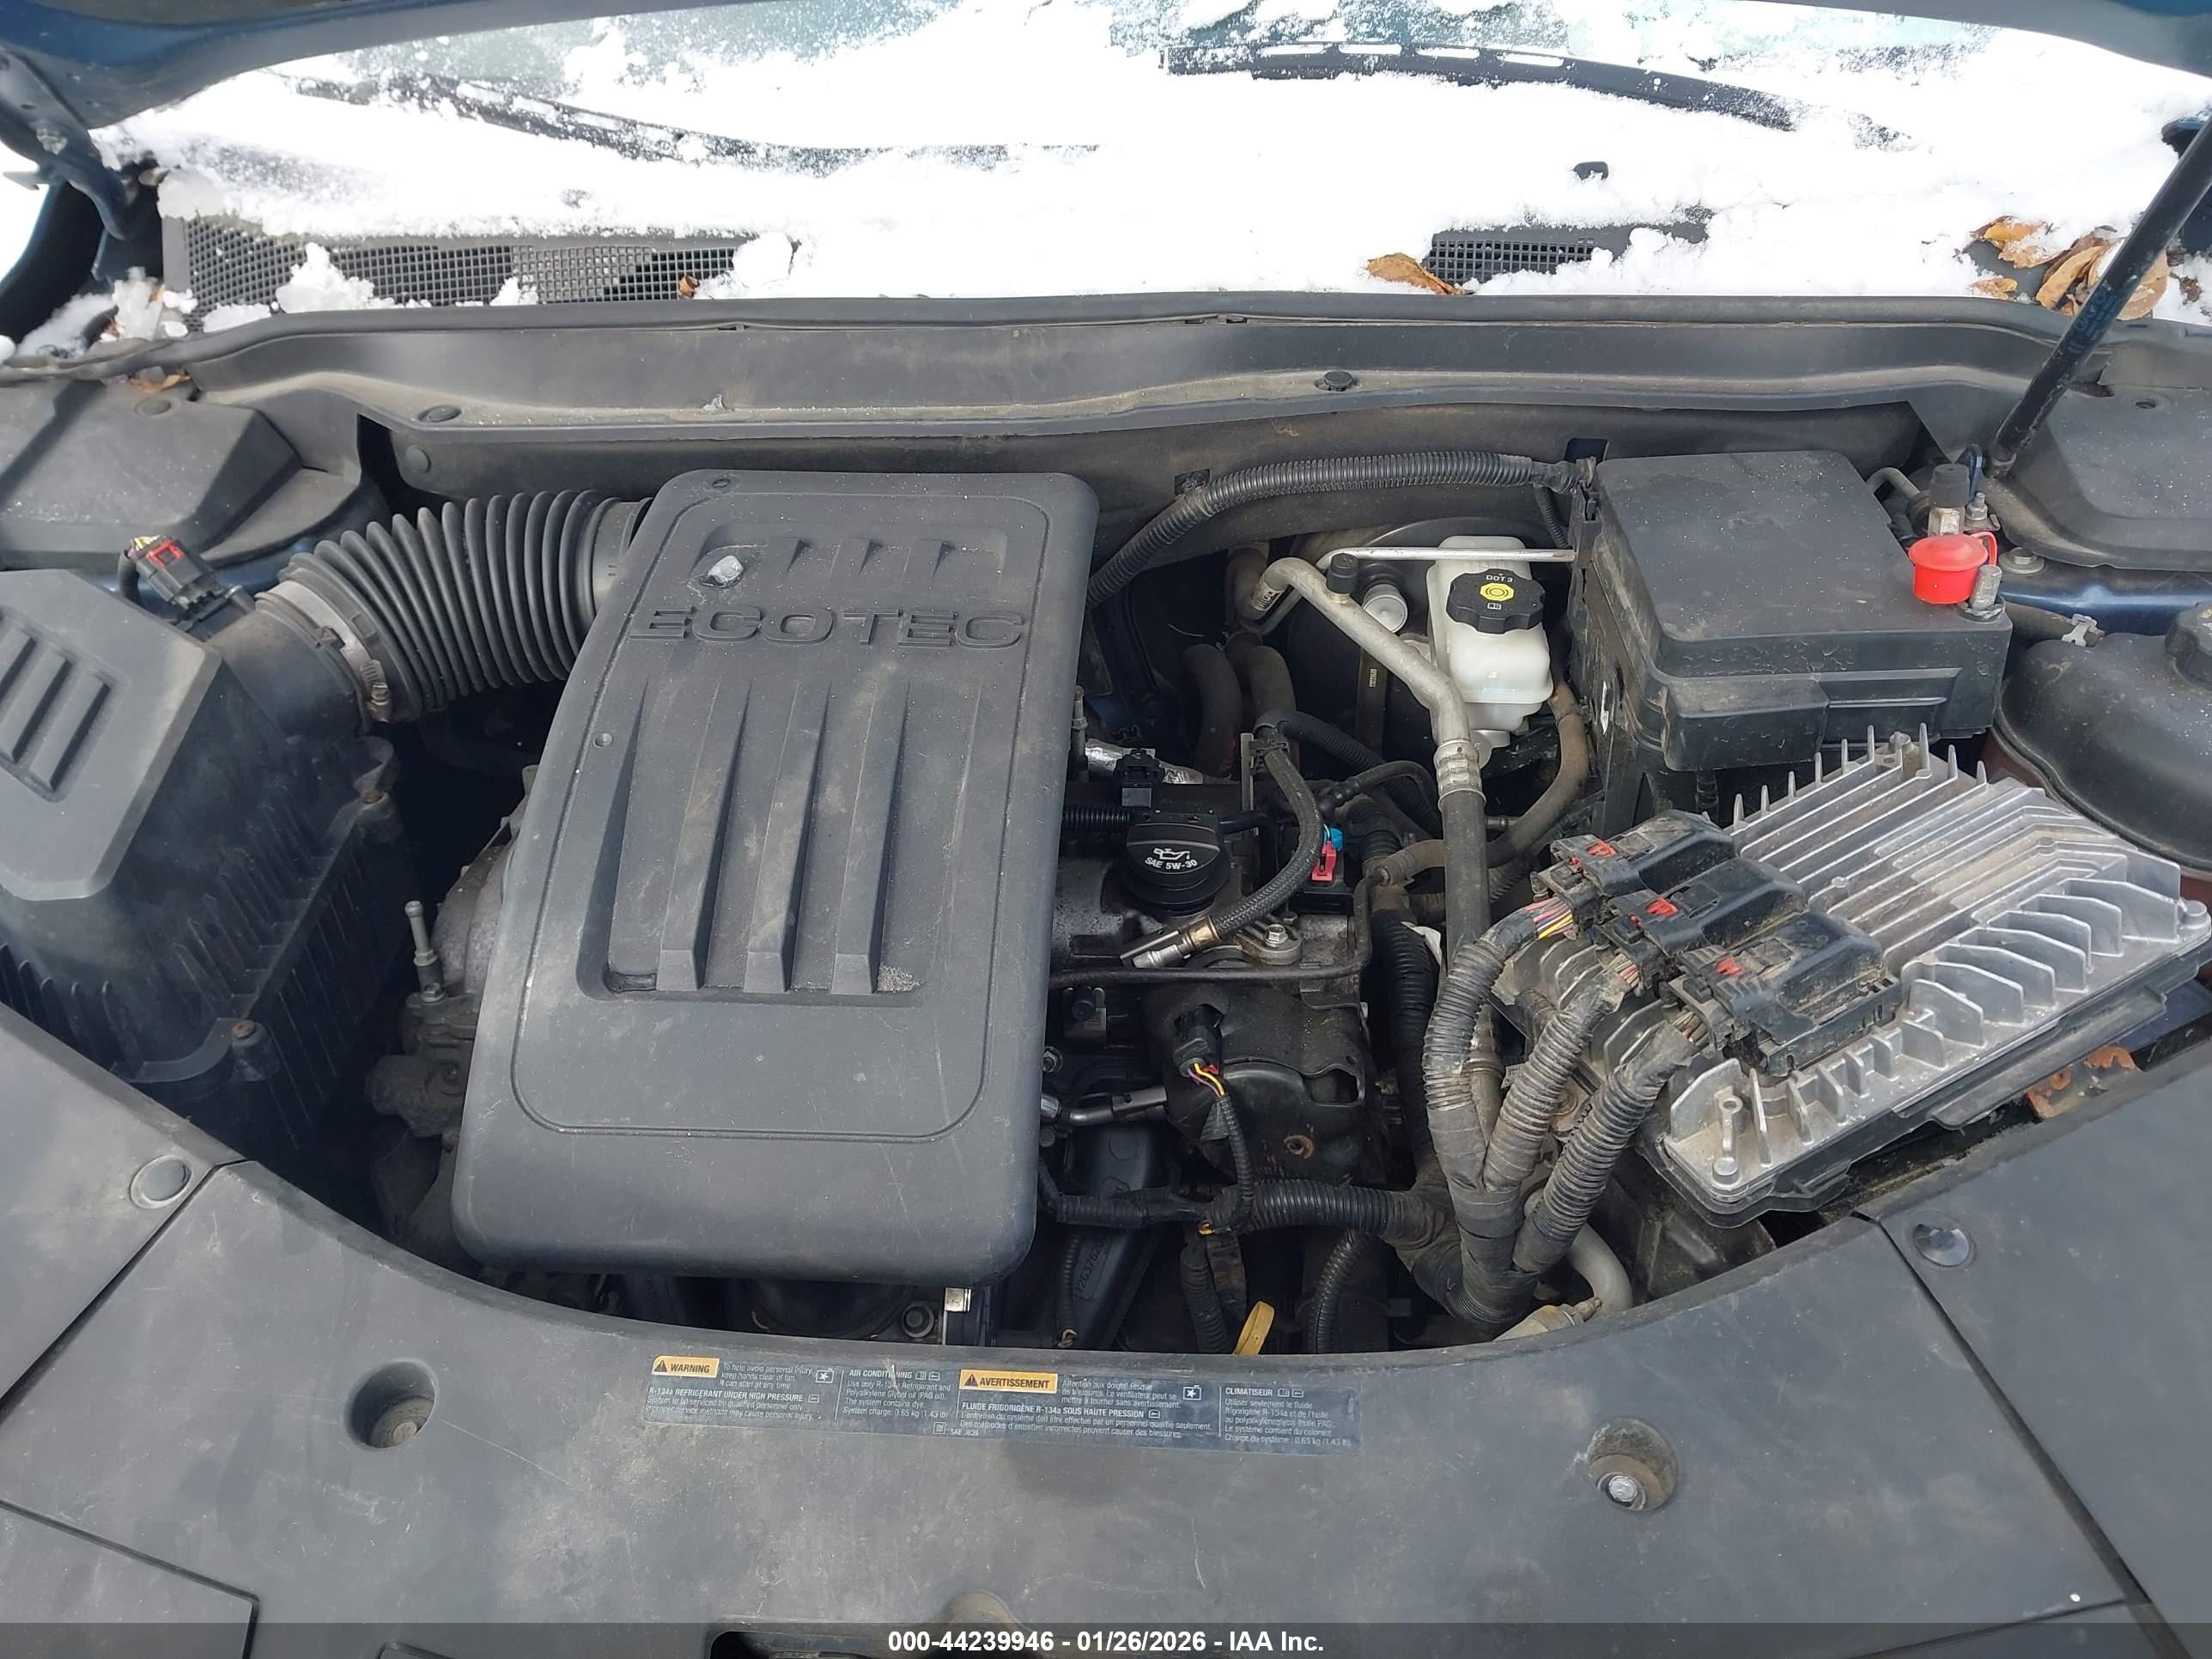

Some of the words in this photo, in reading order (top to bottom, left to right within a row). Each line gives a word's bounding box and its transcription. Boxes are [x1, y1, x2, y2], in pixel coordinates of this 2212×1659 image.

[629, 605, 1030, 650] ECOTEC
[1145, 857, 1164, 869] SAE
[1165, 859, 1198, 870] 5W-30
[671, 1363, 710, 1374] WARNING
[732, 1364, 744, 1372] help
[766, 1365, 793, 1375] personal
[863, 1370, 912, 1379] CONDITINING
[861, 1381, 875, 1389] only
[902, 1382, 937, 1391] Refrigerant
[980, 1376, 1050, 1389] AVERTISSEMENT
[1062, 1379, 1091, 1389] Attention
[1130, 1382, 1153, 1391] Risque
[675, 1389, 722, 1398] REFRIGERANT
[767, 1393, 804, 1401] PRESSURE
[846, 1389, 885, 1398] Polyalkylene
[1225, 1387, 1273, 1396] CLIMATISEUR
[647, 1395, 671, 1405] System
[728, 1401, 757, 1409] qualified
[757, 1402, 787, 1411] personnel
[859, 1399, 882, 1407] system
[912, 1401, 926, 1409] dye.
[1091, 1397, 1114, 1406] tourner
[1133, 1400, 1182, 1409] avertissement.
[1224, 1398, 1248, 1407] Utiliser
[1250, 1400, 1285, 1408] seulement
[765, 1411, 793, 1419] personal
[843, 1407, 867, 1415] System
[869, 1408, 894, 1417] charge:
[911, 1410, 920, 1419] kg
[962, 1401, 987, 1410] FLUIDE
[988, 1402, 1036, 1413] FRIGORIGÈNE
[1036, 1406, 1061, 1414] R-134a
[1062, 1407, 1082, 1415] SOUS
[1083, 1408, 1107, 1417] HAUTE
[1109, 1409, 1144, 1419] PRESSION
[1262, 1408, 1288, 1417] R-134a
[1006, 1413, 1035, 1422] système
[1115, 1419, 1148, 1429] personnel
[1044, 1425, 1081, 1433] incorrectes
[1083, 1426, 1109, 1436] peuvent
[1235, 1425, 1263, 1434] système
[1265, 1426, 1291, 1435] contient
[1224, 1433, 1249, 1443] Charge
[1295, 1436, 1311, 1444] 0.65
[1312, 1437, 1322, 1446] kg
